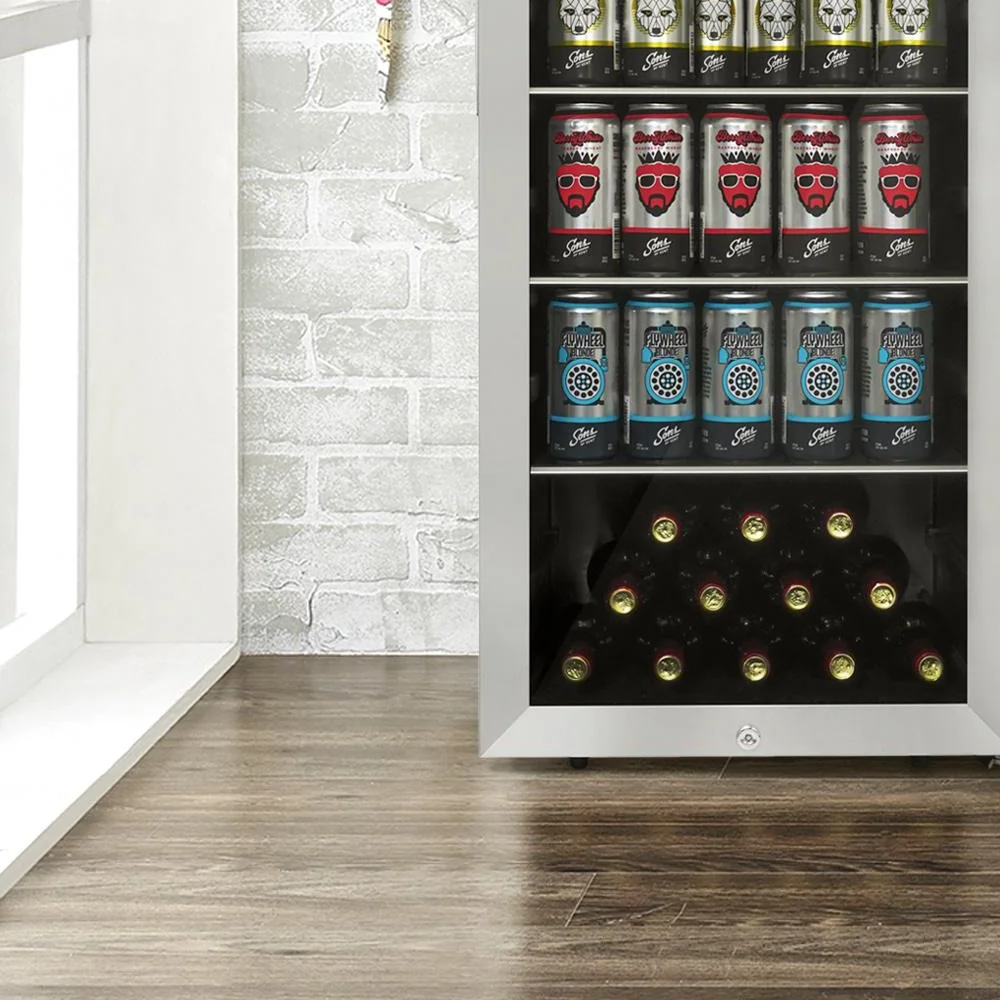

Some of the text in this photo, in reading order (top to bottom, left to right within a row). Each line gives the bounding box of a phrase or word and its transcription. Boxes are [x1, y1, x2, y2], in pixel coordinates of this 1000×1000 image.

[562, 333, 605, 349] FLYWHEEL
[646, 333, 688, 349] FLYWHEEL
[723, 333, 762, 349] FLYWHEEL
[802, 333, 845, 349] FLYWHEEL
[882, 333, 923, 349] FLYWHEEL
